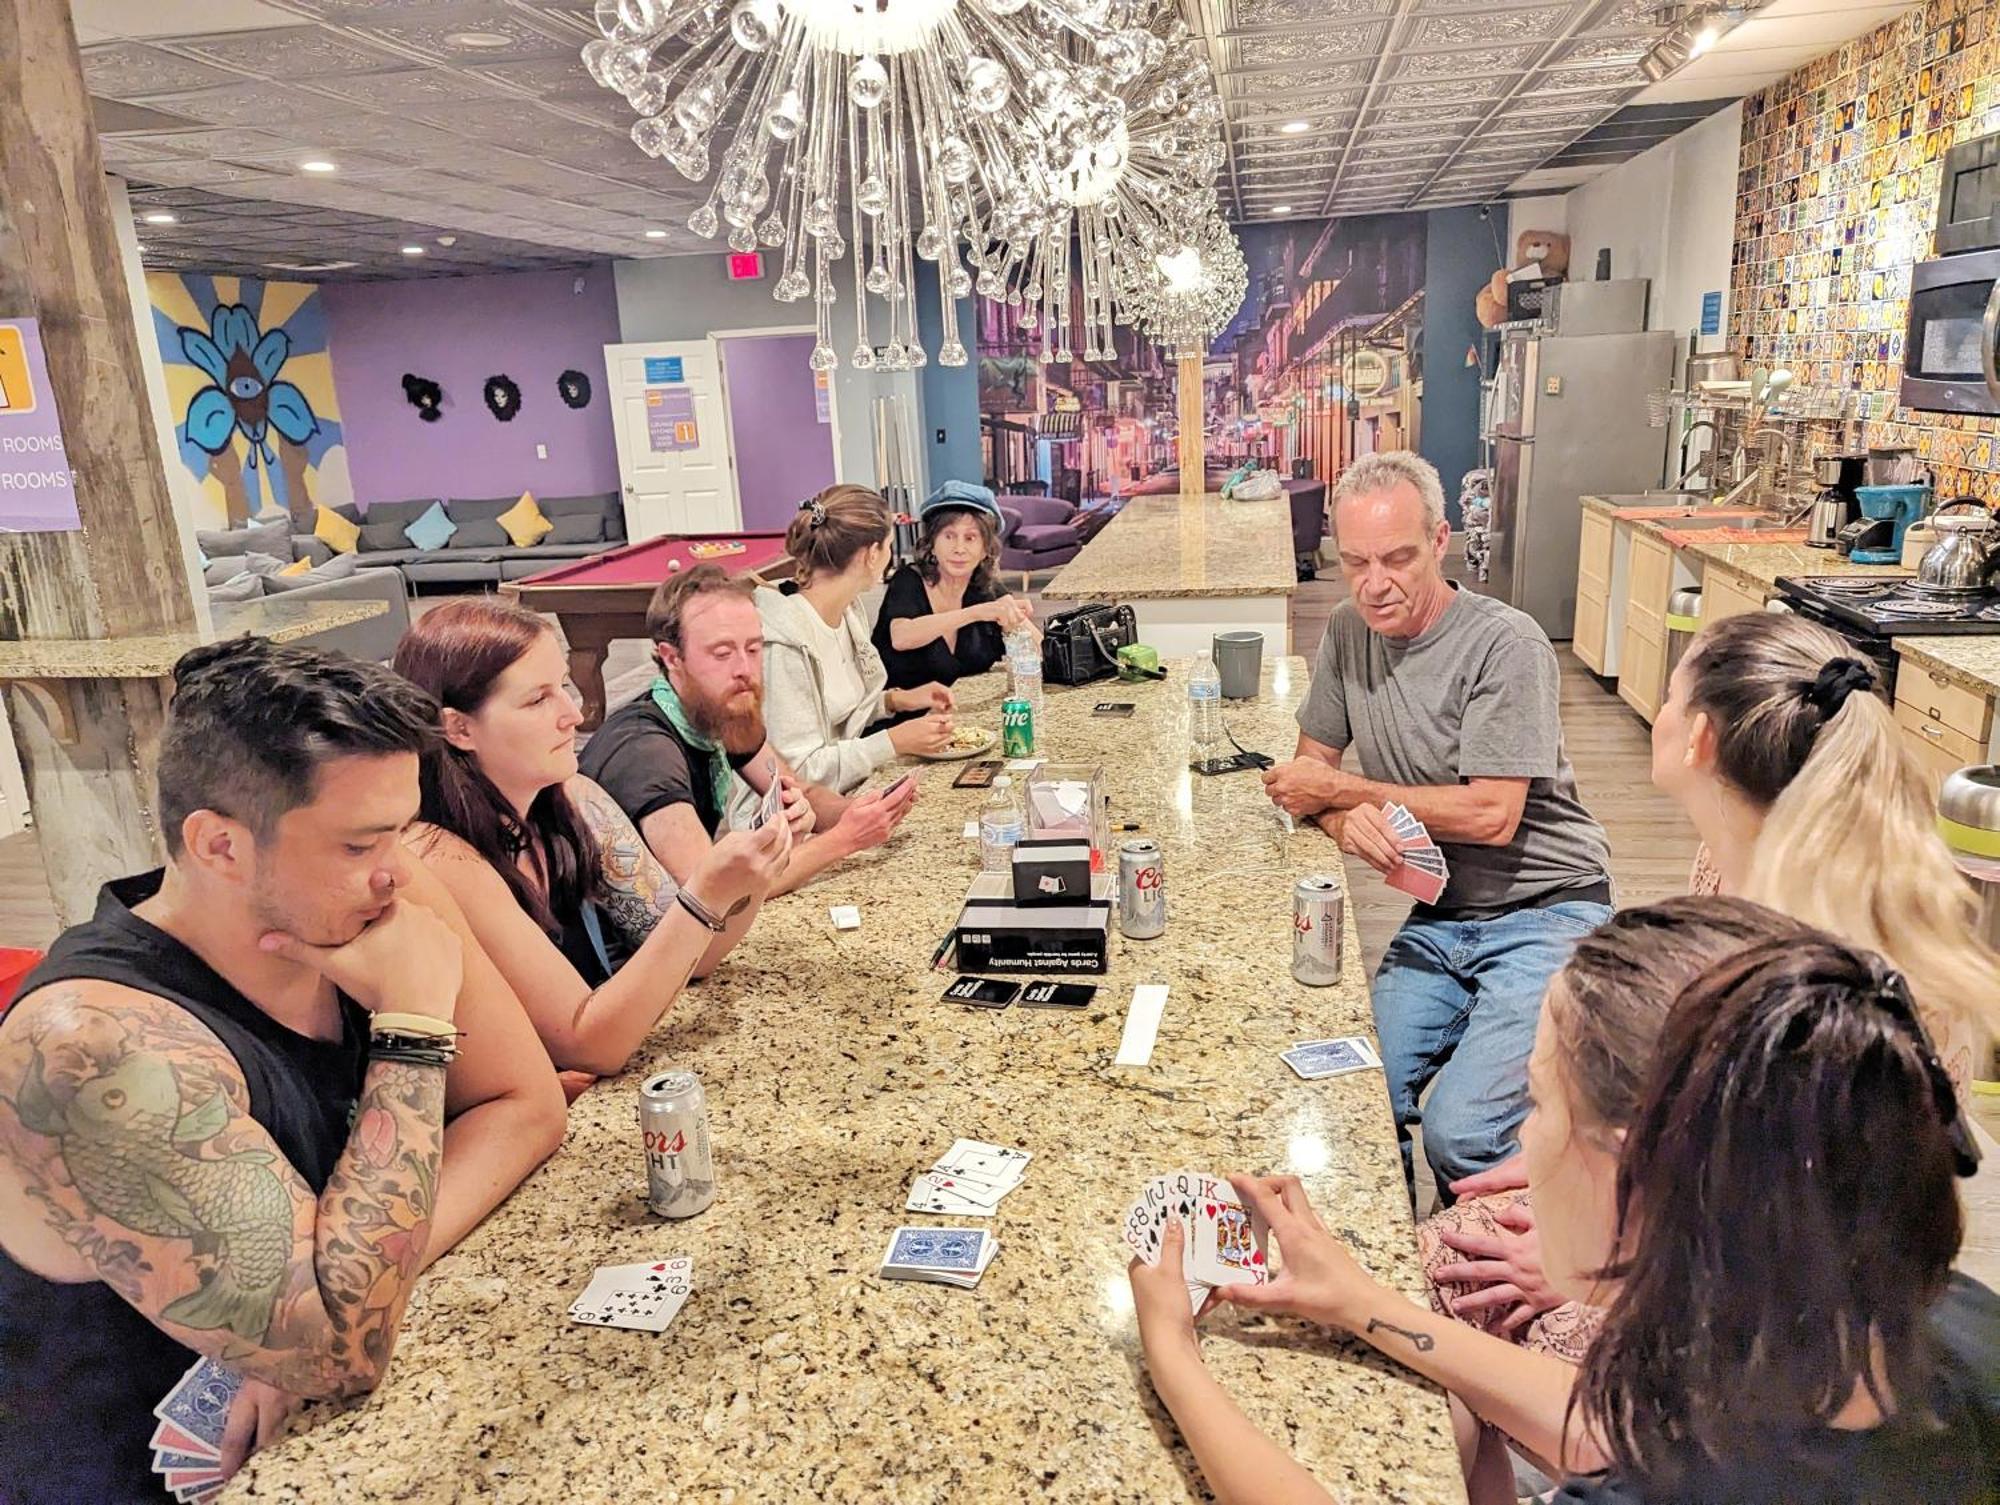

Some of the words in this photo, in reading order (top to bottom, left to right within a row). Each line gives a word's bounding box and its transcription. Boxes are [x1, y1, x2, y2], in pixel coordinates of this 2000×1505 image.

[3, 434, 63, 452] ROOMS
[1, 471, 67, 489] ROOMS
[989, 957, 1032, 968] Humanity
[1034, 958, 1069, 968] Against
[1070, 959, 1099, 968] Cards
[644, 1130, 687, 1153] ors
[1155, 1181, 1165, 1200] J
[1176, 1175, 1190, 1197] Q
[1204, 1180, 1218, 1200] K
[1134, 1206, 1149, 1226] 8
